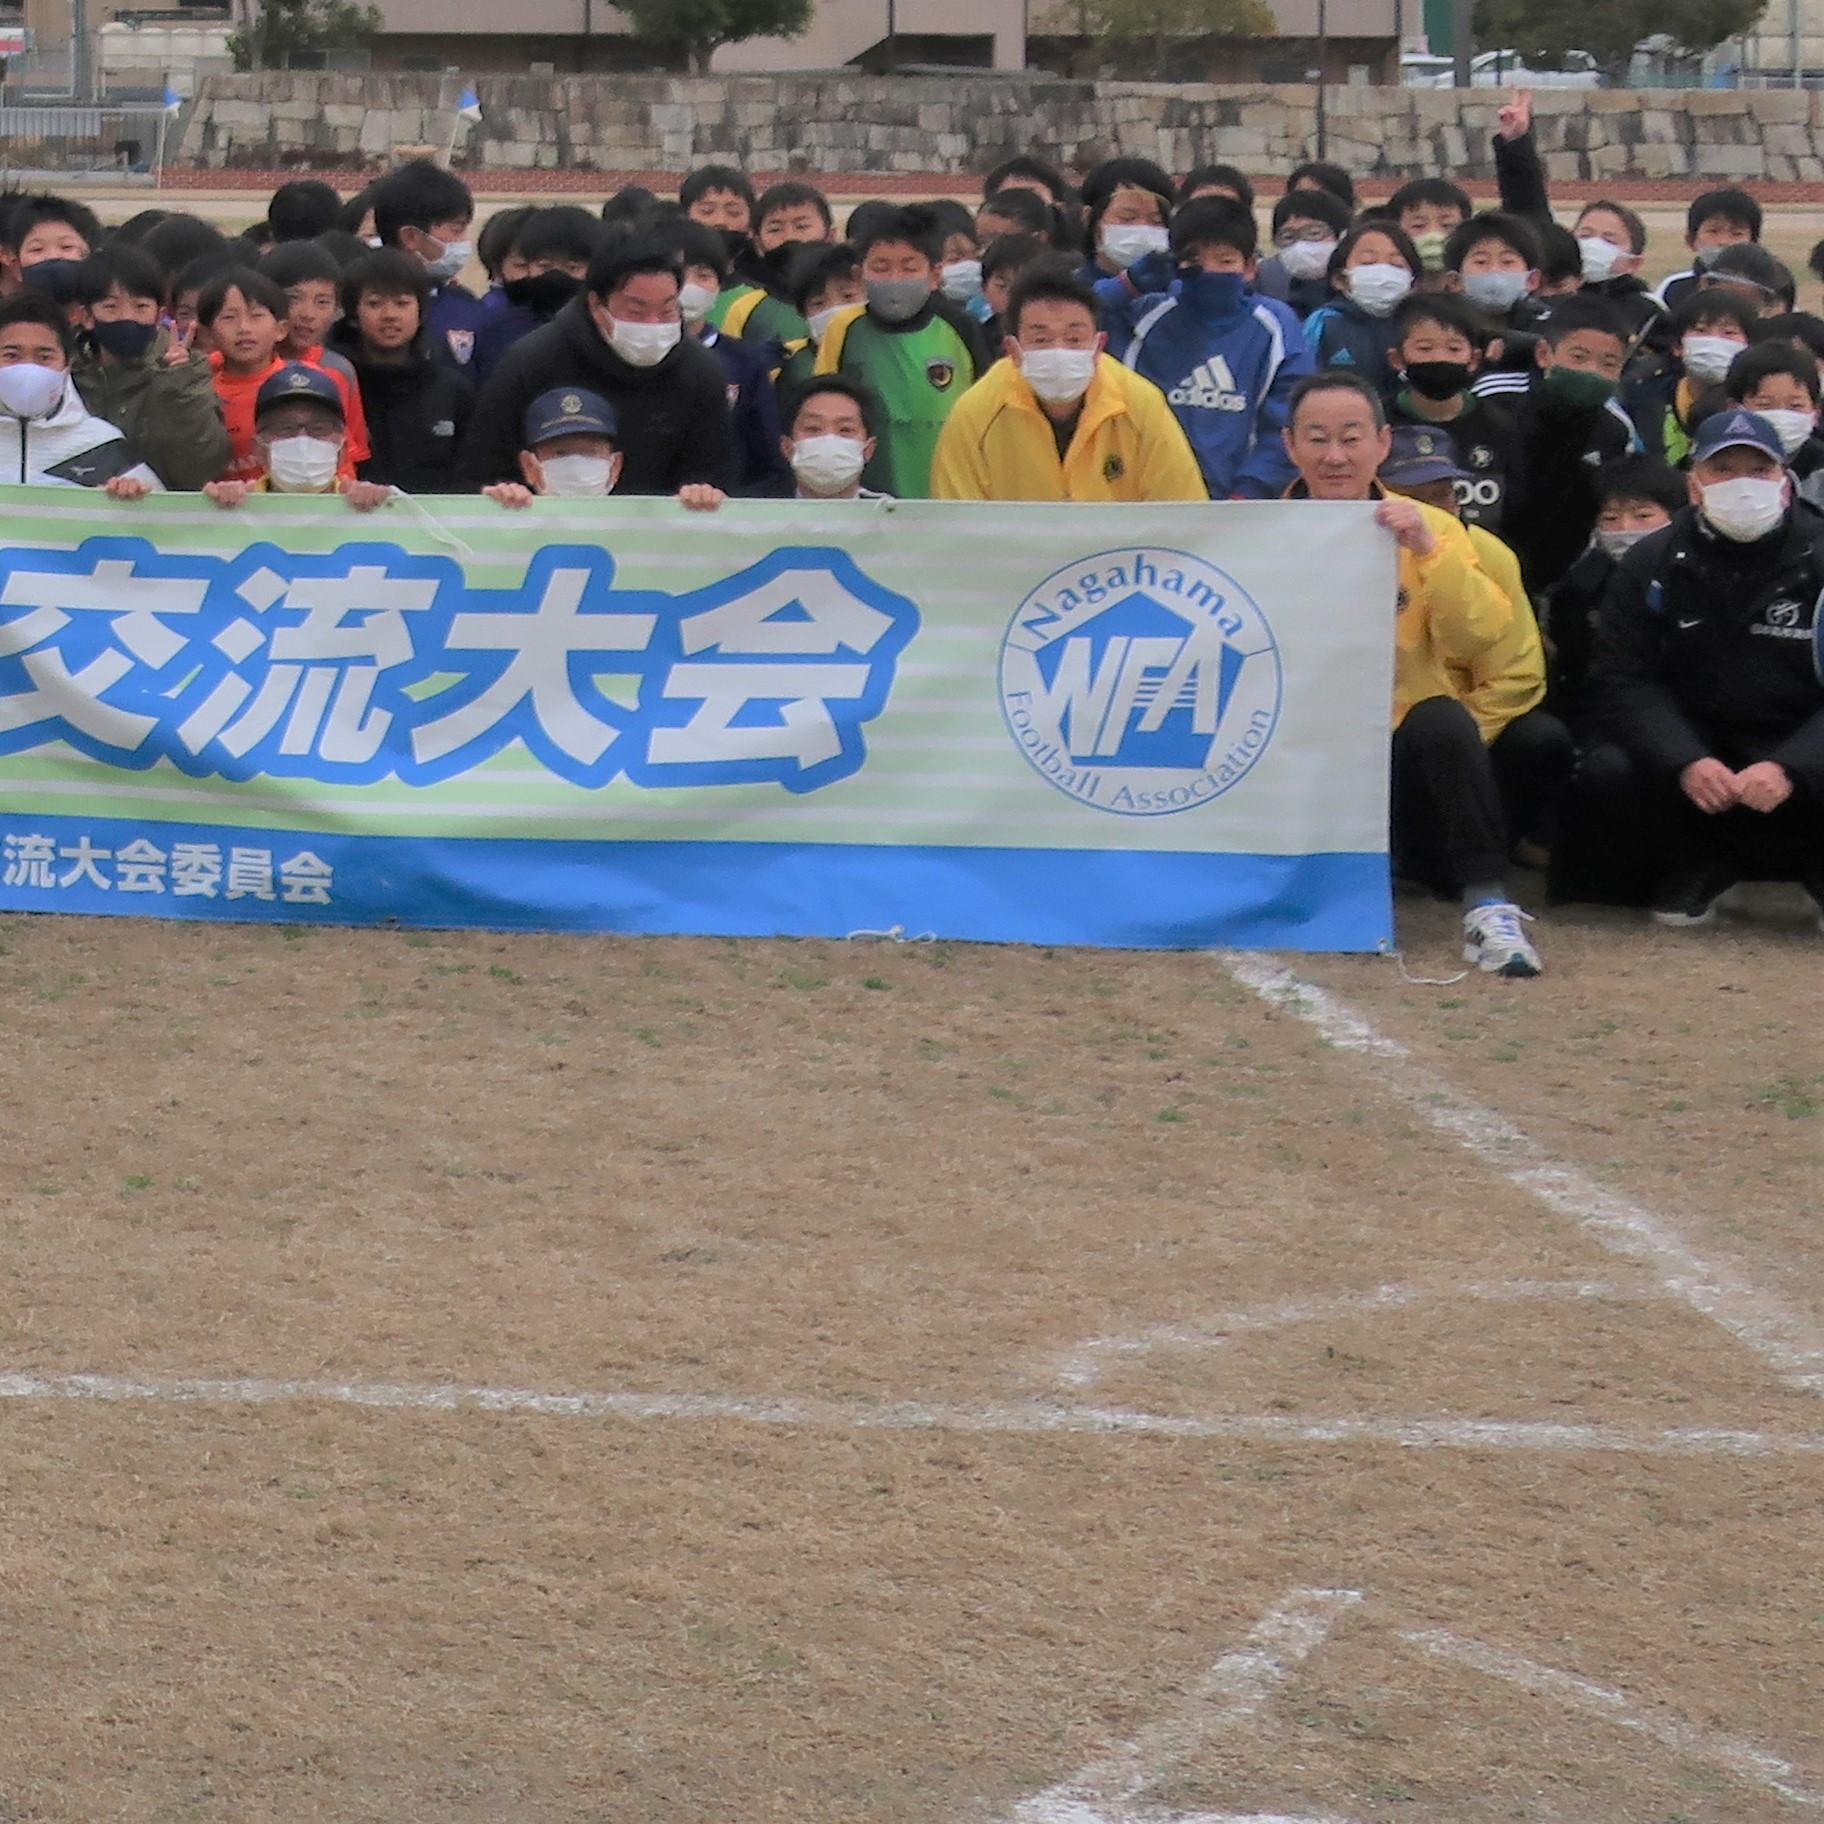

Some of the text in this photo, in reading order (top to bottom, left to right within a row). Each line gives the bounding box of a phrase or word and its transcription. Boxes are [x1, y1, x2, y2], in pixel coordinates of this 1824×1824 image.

[1168, 386, 1247, 412] adidas
[1021, 553, 1244, 642] Nagahama
[1052, 626, 1222, 757] NFA
[1007, 690, 1272, 810] Football Association
